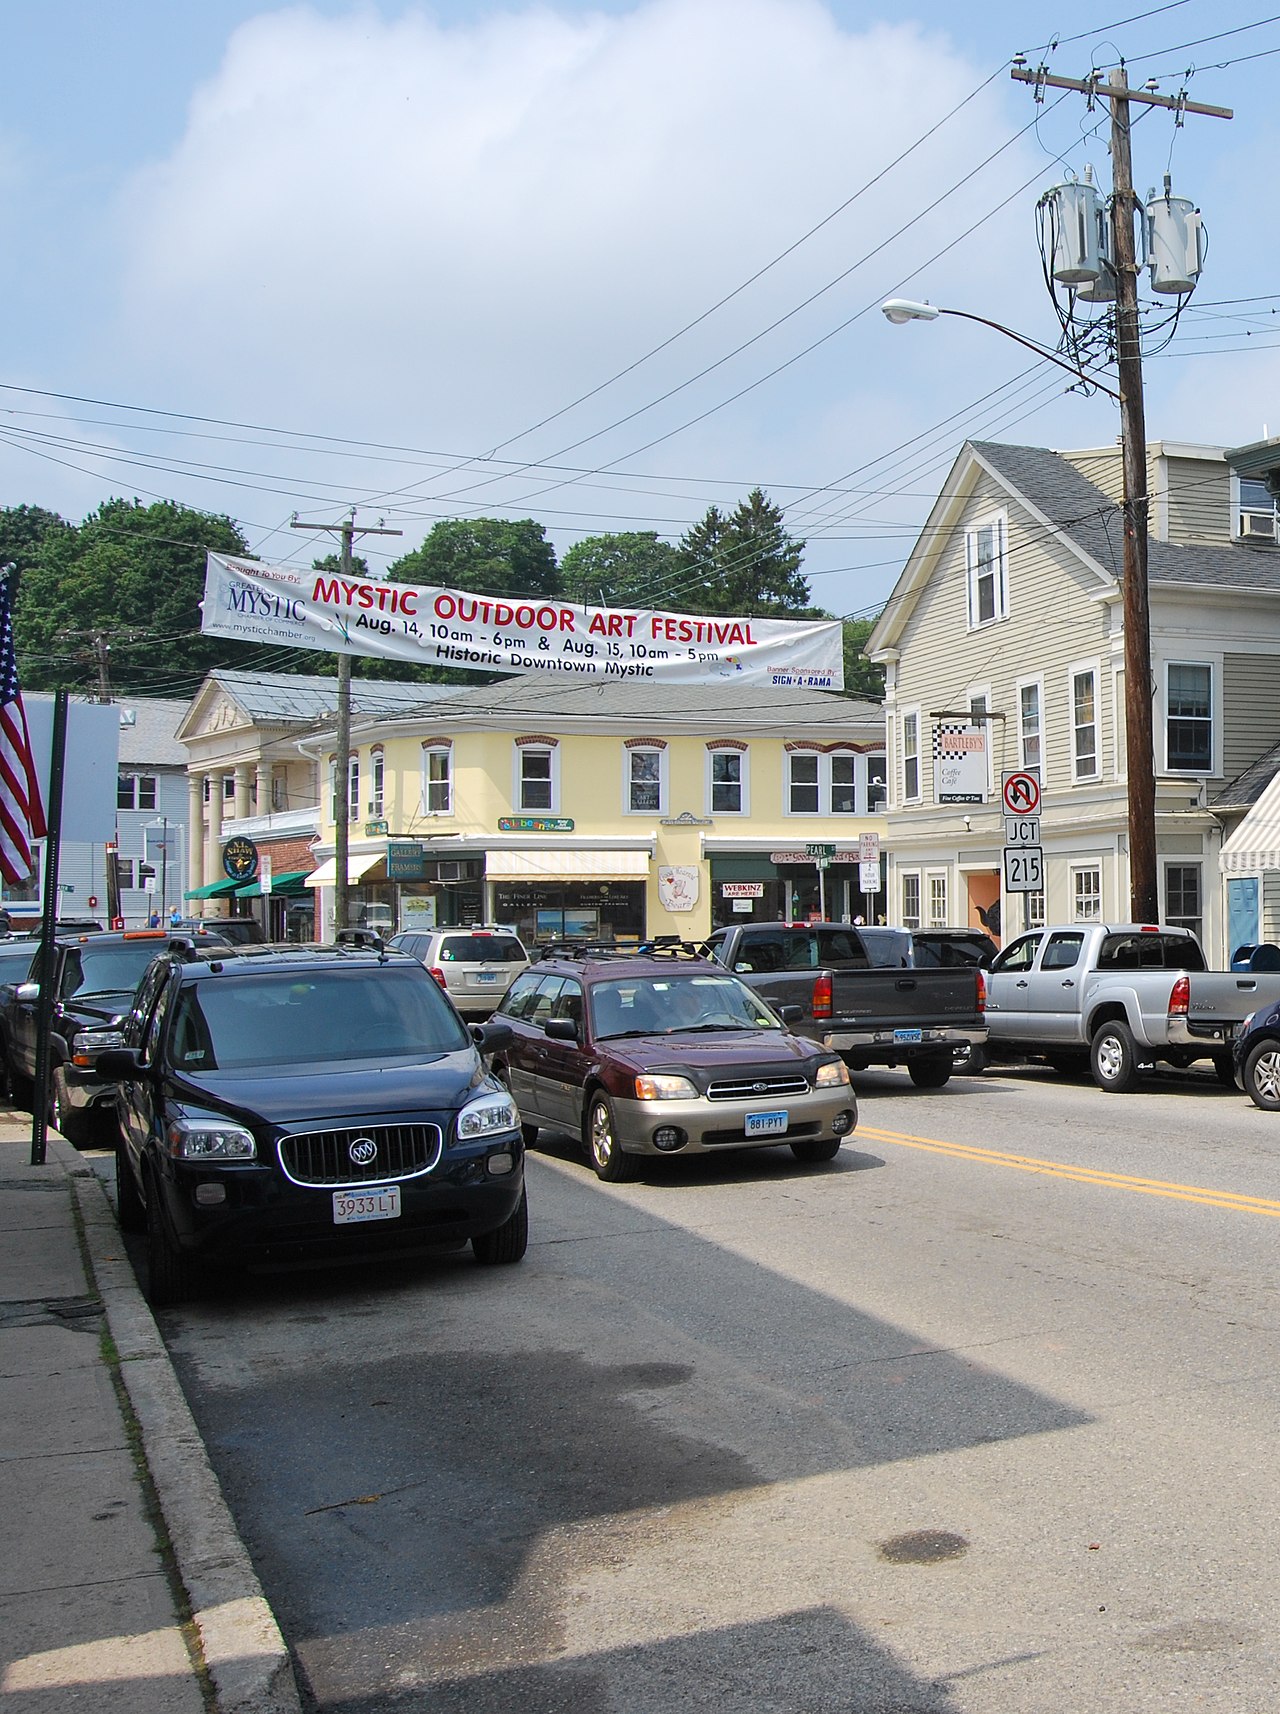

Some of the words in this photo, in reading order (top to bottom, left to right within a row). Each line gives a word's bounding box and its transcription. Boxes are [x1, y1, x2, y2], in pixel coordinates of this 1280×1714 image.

[262, 570, 270, 578] To
[271, 571, 286, 580] You
[227, 588, 306, 622] MYSTIC
[312, 577, 418, 615] MYSTIC
[434, 594, 575, 632] OUTDOOR
[588, 613, 638, 637] ART
[652, 618, 758, 645] FESTIVAL
[212, 622, 316, 642] www.mysticchamber.org
[355, 613, 396, 635] Aug.
[402, 620, 423, 638] 14,
[492, 632, 526, 650] 6pm
[538, 636, 550, 650] &
[563, 638, 598, 657] Aug.
[607, 642, 624, 659] 15,
[688, 648, 718, 663] 5pm
[436, 645, 501, 665] Historic
[510, 653, 596, 673] Downtown
[605, 661, 654, 678] Mystic
[944, 737, 983, 749] BARTLEBY'S
[942, 768, 961, 777] Coffee
[1009, 822, 1036, 840] JCT
[806, 845, 827, 855] PEARL
[1011, 858, 1039, 882] 215
[337, 1197, 374, 1216] 3933
[379, 1195, 396, 1211] LT
